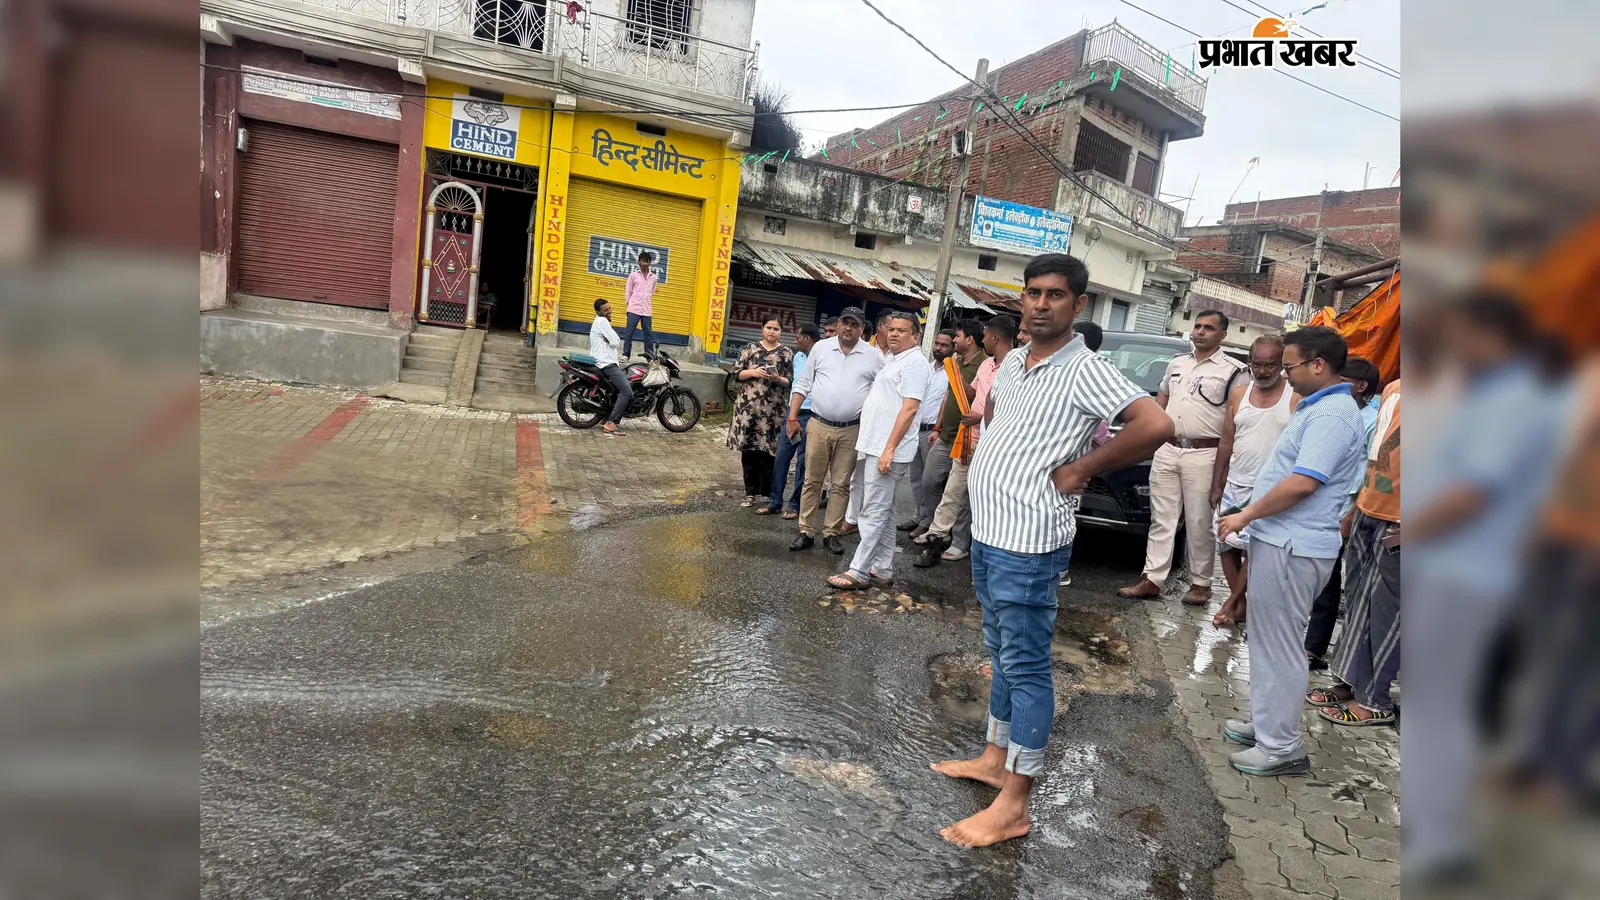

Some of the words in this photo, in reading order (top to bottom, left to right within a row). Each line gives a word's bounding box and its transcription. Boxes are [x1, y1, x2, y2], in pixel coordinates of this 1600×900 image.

[453, 137, 514, 158] CEMENT
[457, 122, 512, 145] HIND
[591, 128, 641, 172] हिन्द
[641, 140, 705, 178] सीमेन्ट
[546, 194, 564, 244] HIND
[593, 258, 665, 280] CEMET
[598, 240, 661, 265] HIND
[715, 224, 732, 270] HIND
[542, 249, 560, 322] CEMENT
[709, 275, 727, 343] CEMENT
